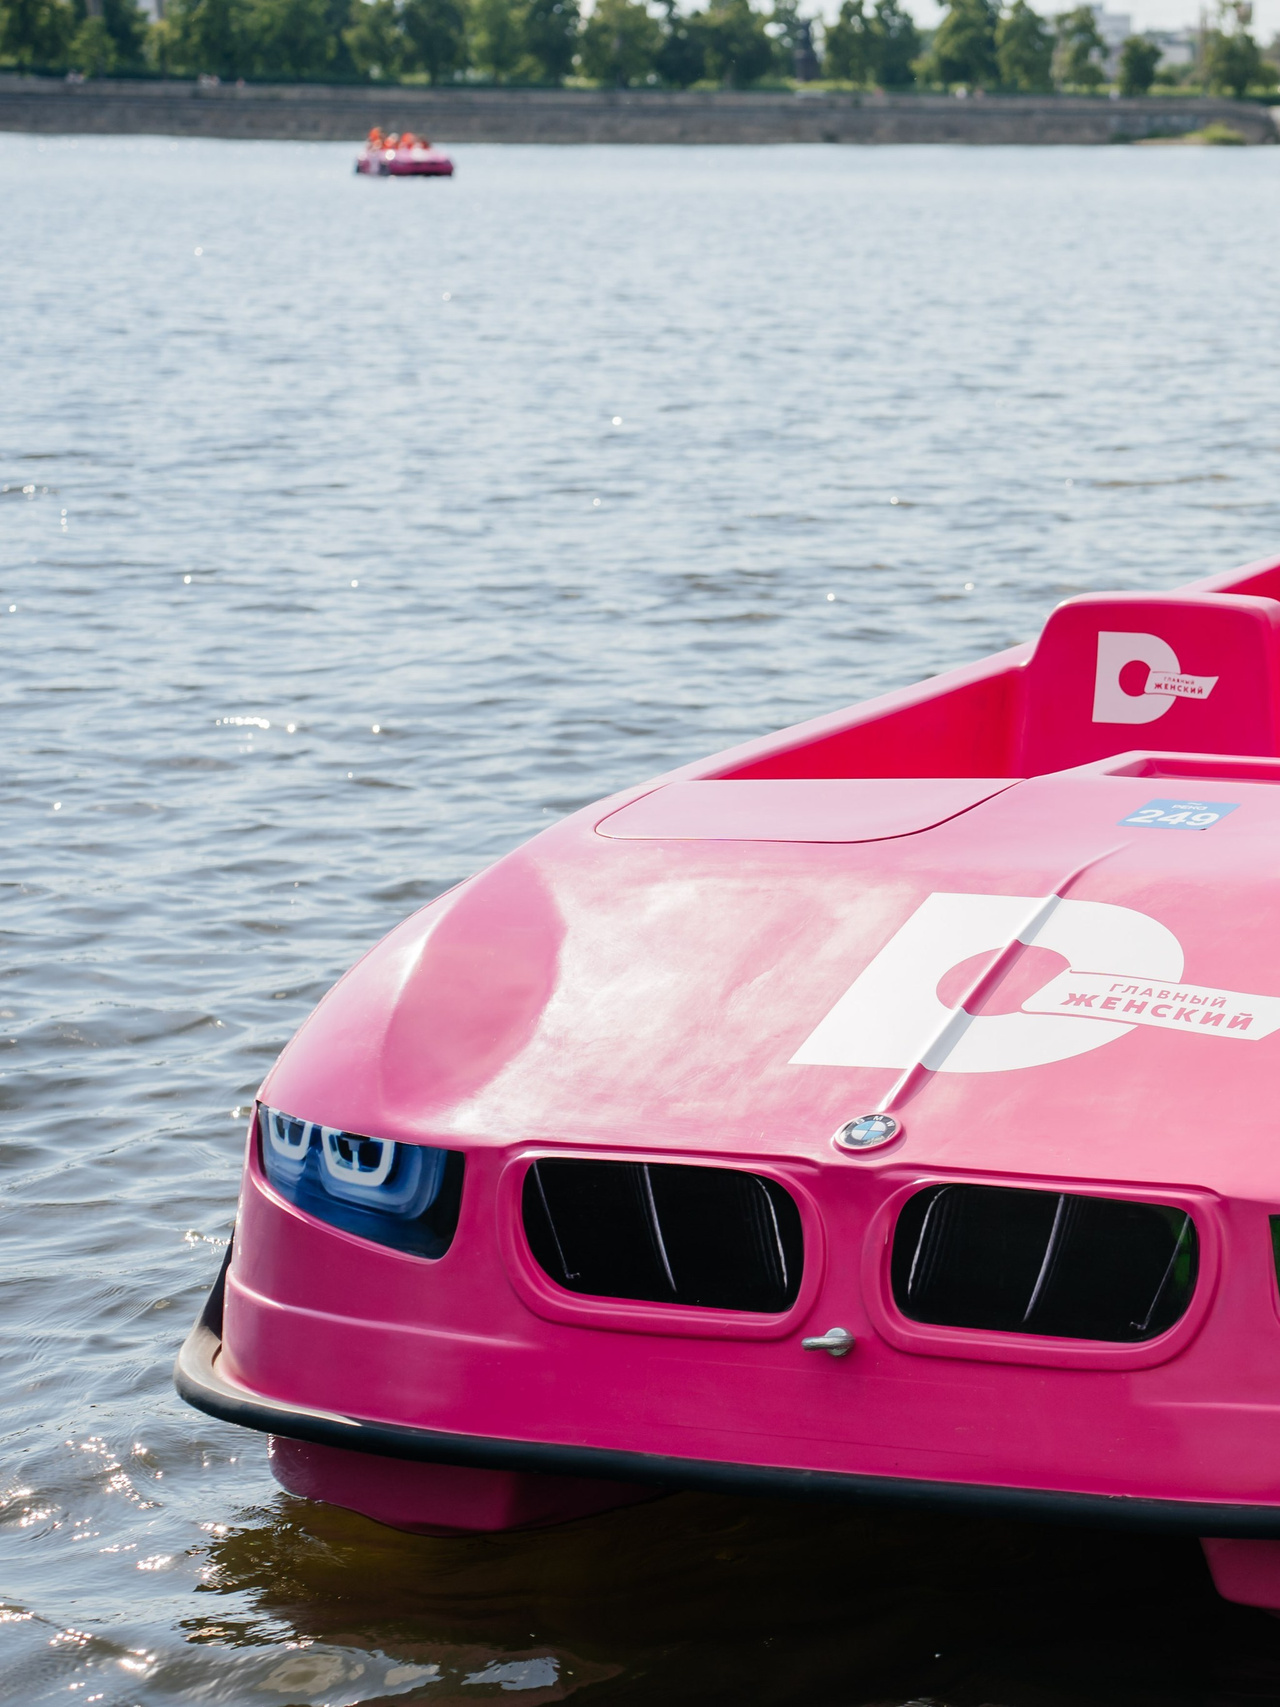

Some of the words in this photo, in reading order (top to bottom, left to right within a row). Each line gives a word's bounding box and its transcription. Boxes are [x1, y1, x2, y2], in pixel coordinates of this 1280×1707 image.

[1154, 682, 1204, 695] ЖЕНСКИЙ
[1124, 808, 1220, 827] 249
[1109, 983, 1227, 1009] ГЛАВНЫЙ
[1060, 992, 1254, 1031] ЖЕНСКИЙ
